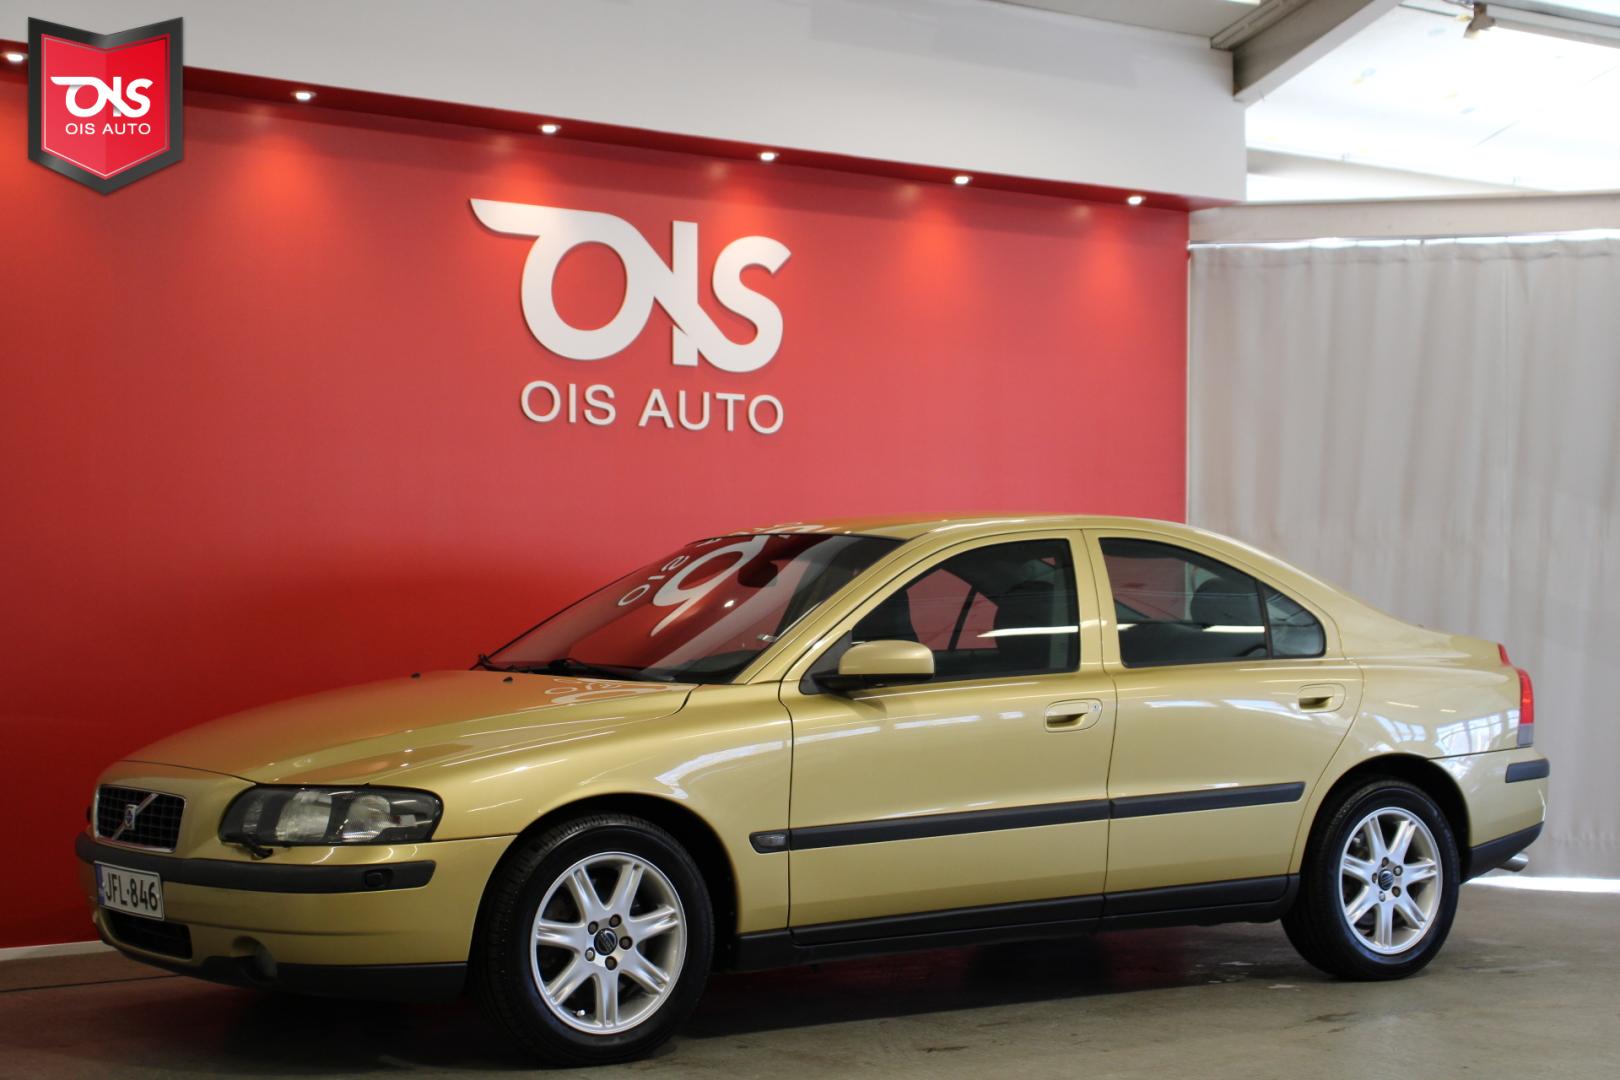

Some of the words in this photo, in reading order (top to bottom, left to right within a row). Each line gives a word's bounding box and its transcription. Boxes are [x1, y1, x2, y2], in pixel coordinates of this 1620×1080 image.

[470, 198, 792, 373] OIS
[520, 380, 617, 426] OIS
[638, 388, 784, 434] AUTO
[105, 871, 158, 911] JFL-846
